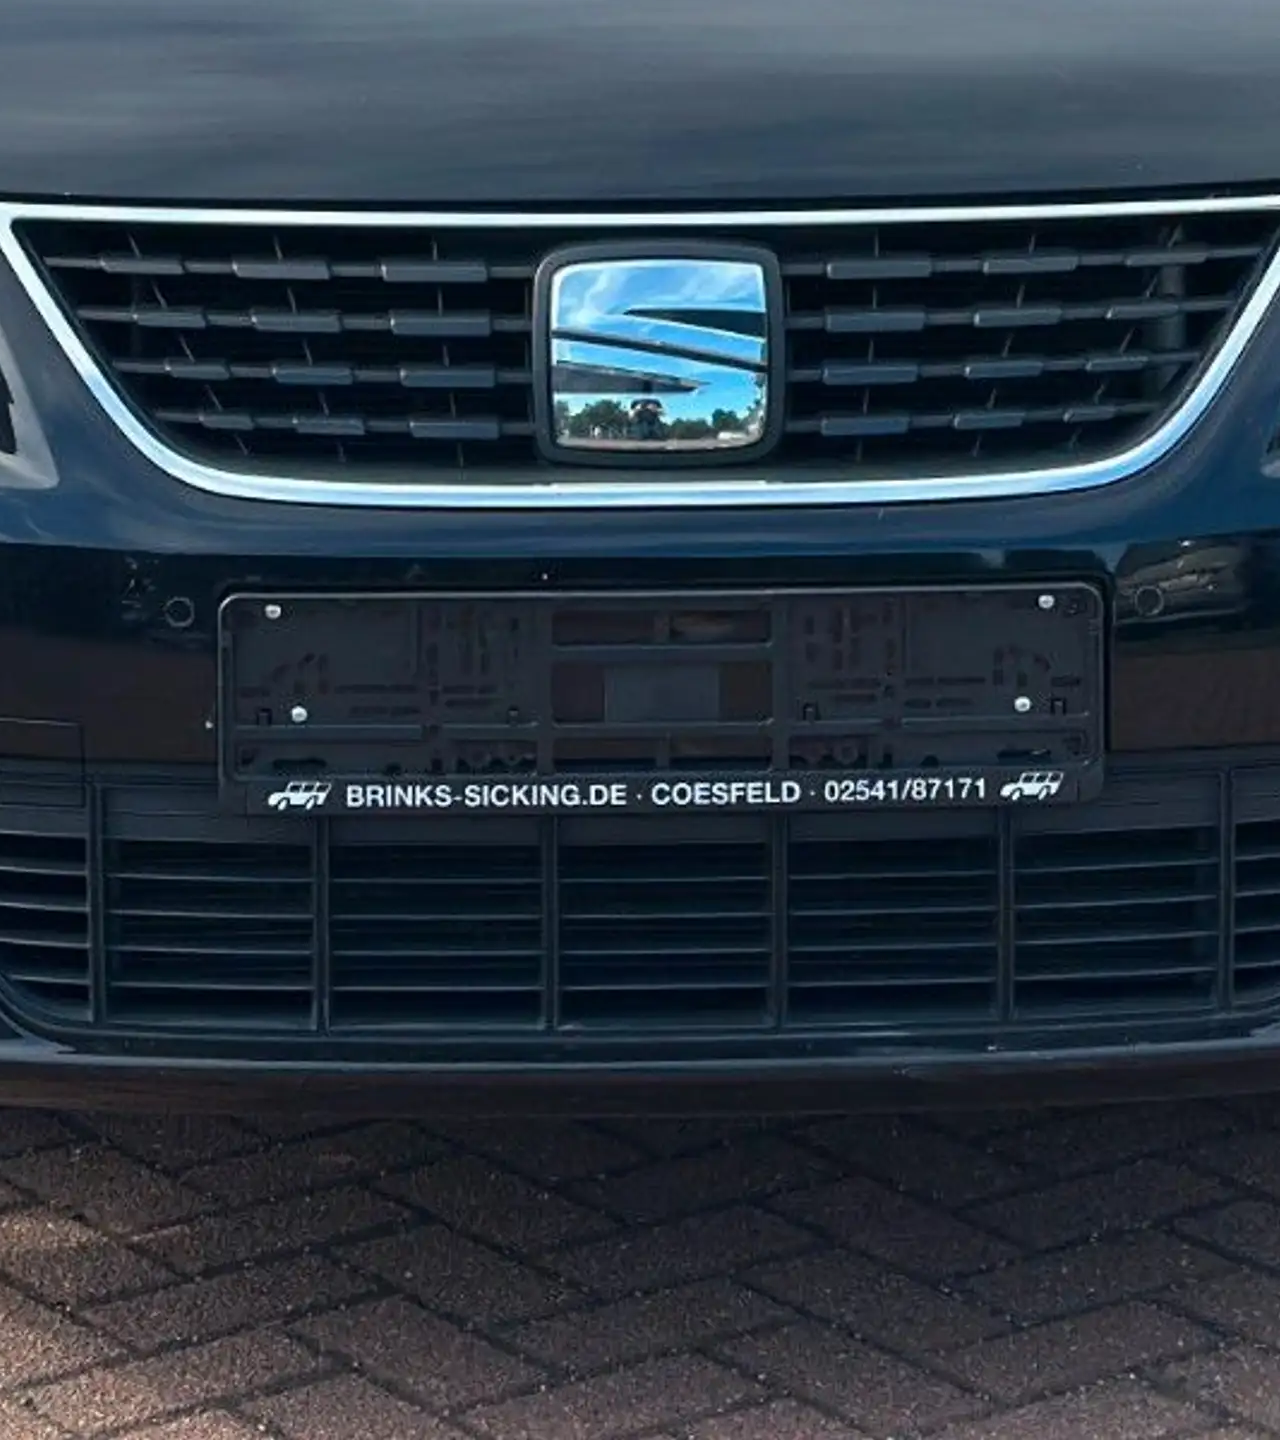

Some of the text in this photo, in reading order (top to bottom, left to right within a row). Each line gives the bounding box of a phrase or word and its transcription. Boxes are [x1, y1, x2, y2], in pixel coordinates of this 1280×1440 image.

[345, 776, 986, 809] BRINKS-SICKING.DE COESFELD 02541/87171
